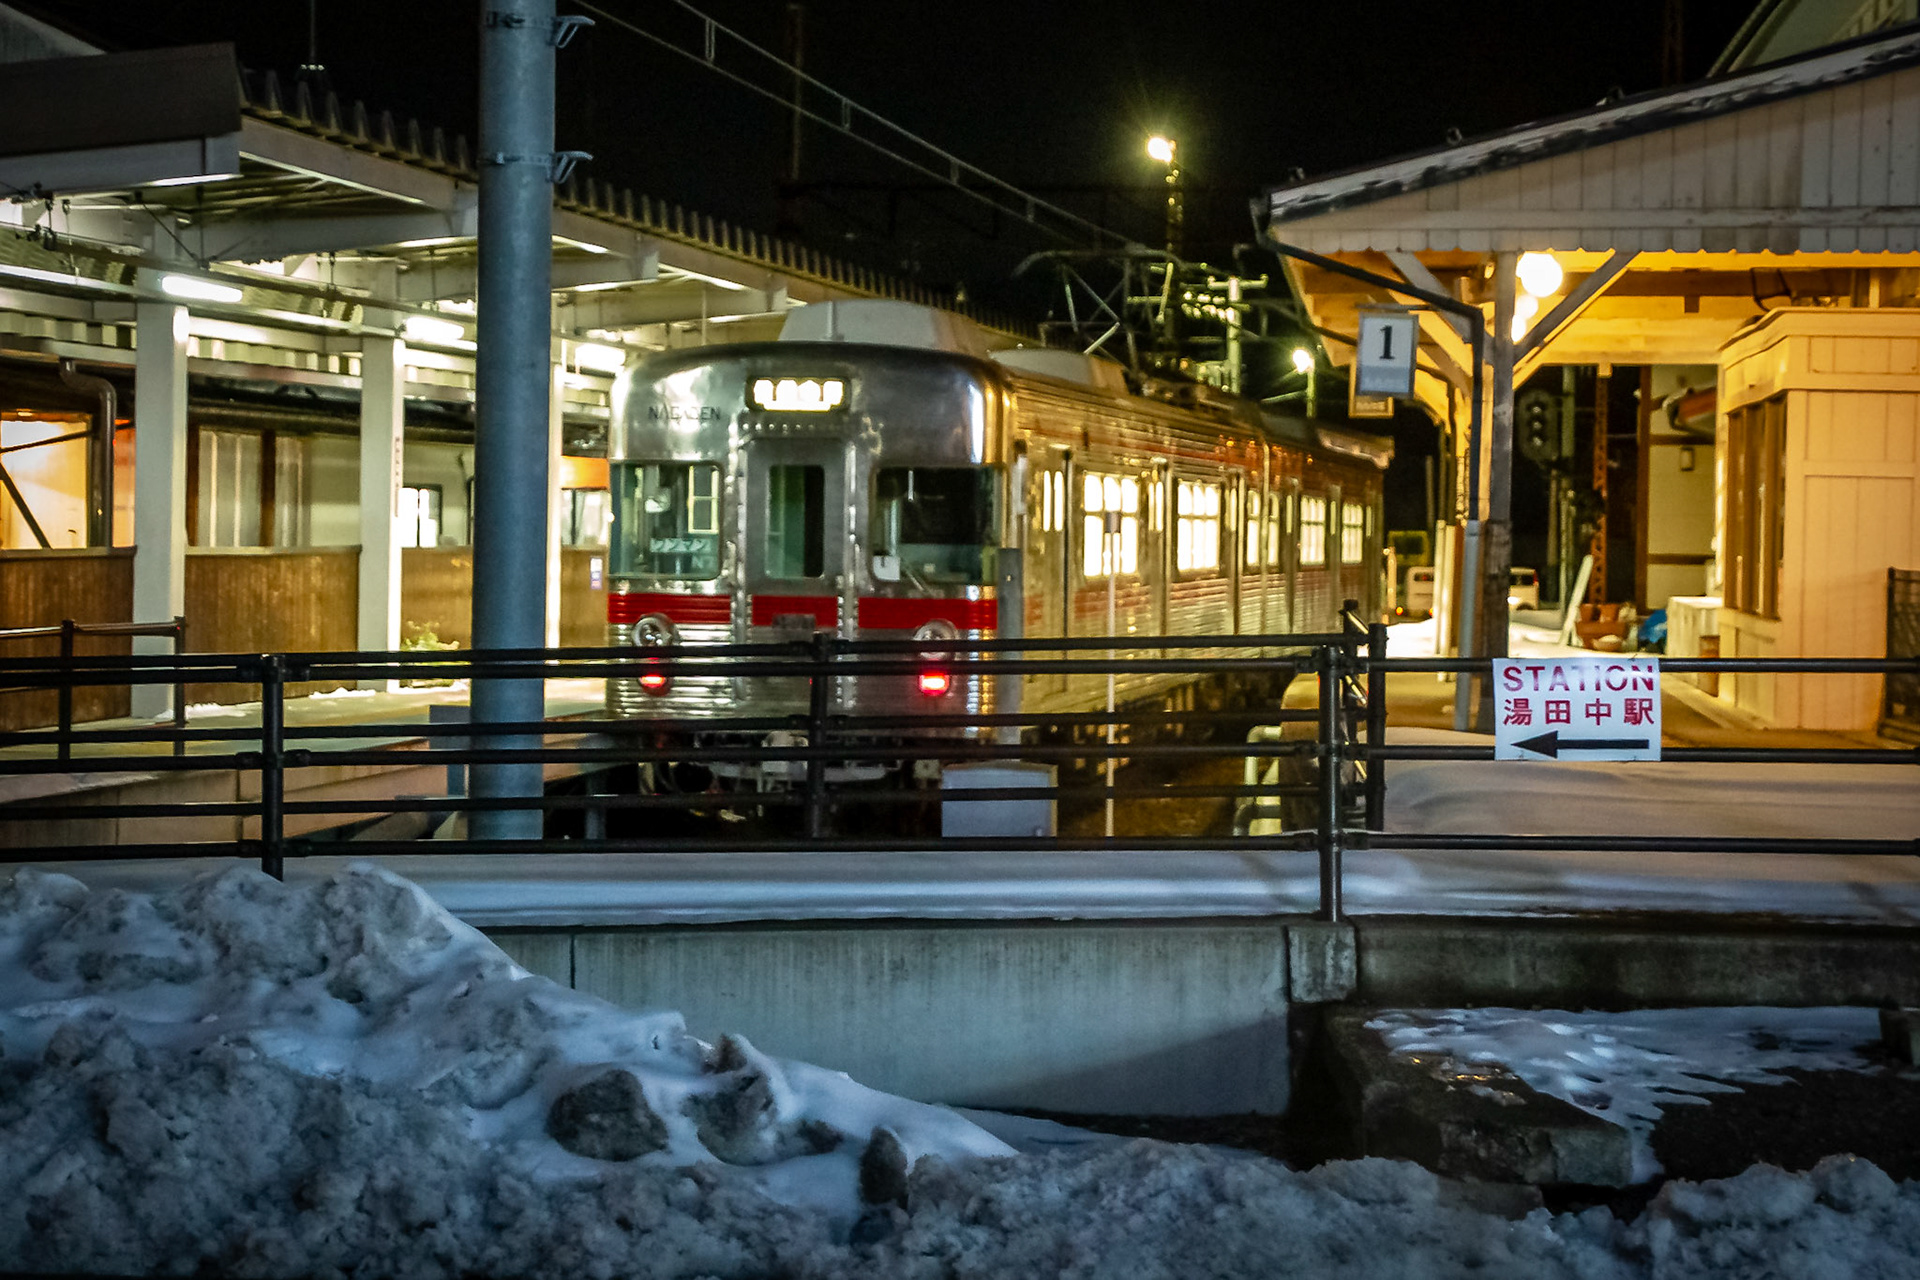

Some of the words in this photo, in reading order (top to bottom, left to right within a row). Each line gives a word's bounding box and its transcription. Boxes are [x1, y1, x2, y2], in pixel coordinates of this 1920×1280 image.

[1379, 324, 1395, 360] 1
[1503, 665, 1655, 692] STATION
[1503, 698, 1655, 726] 湯田中駅
